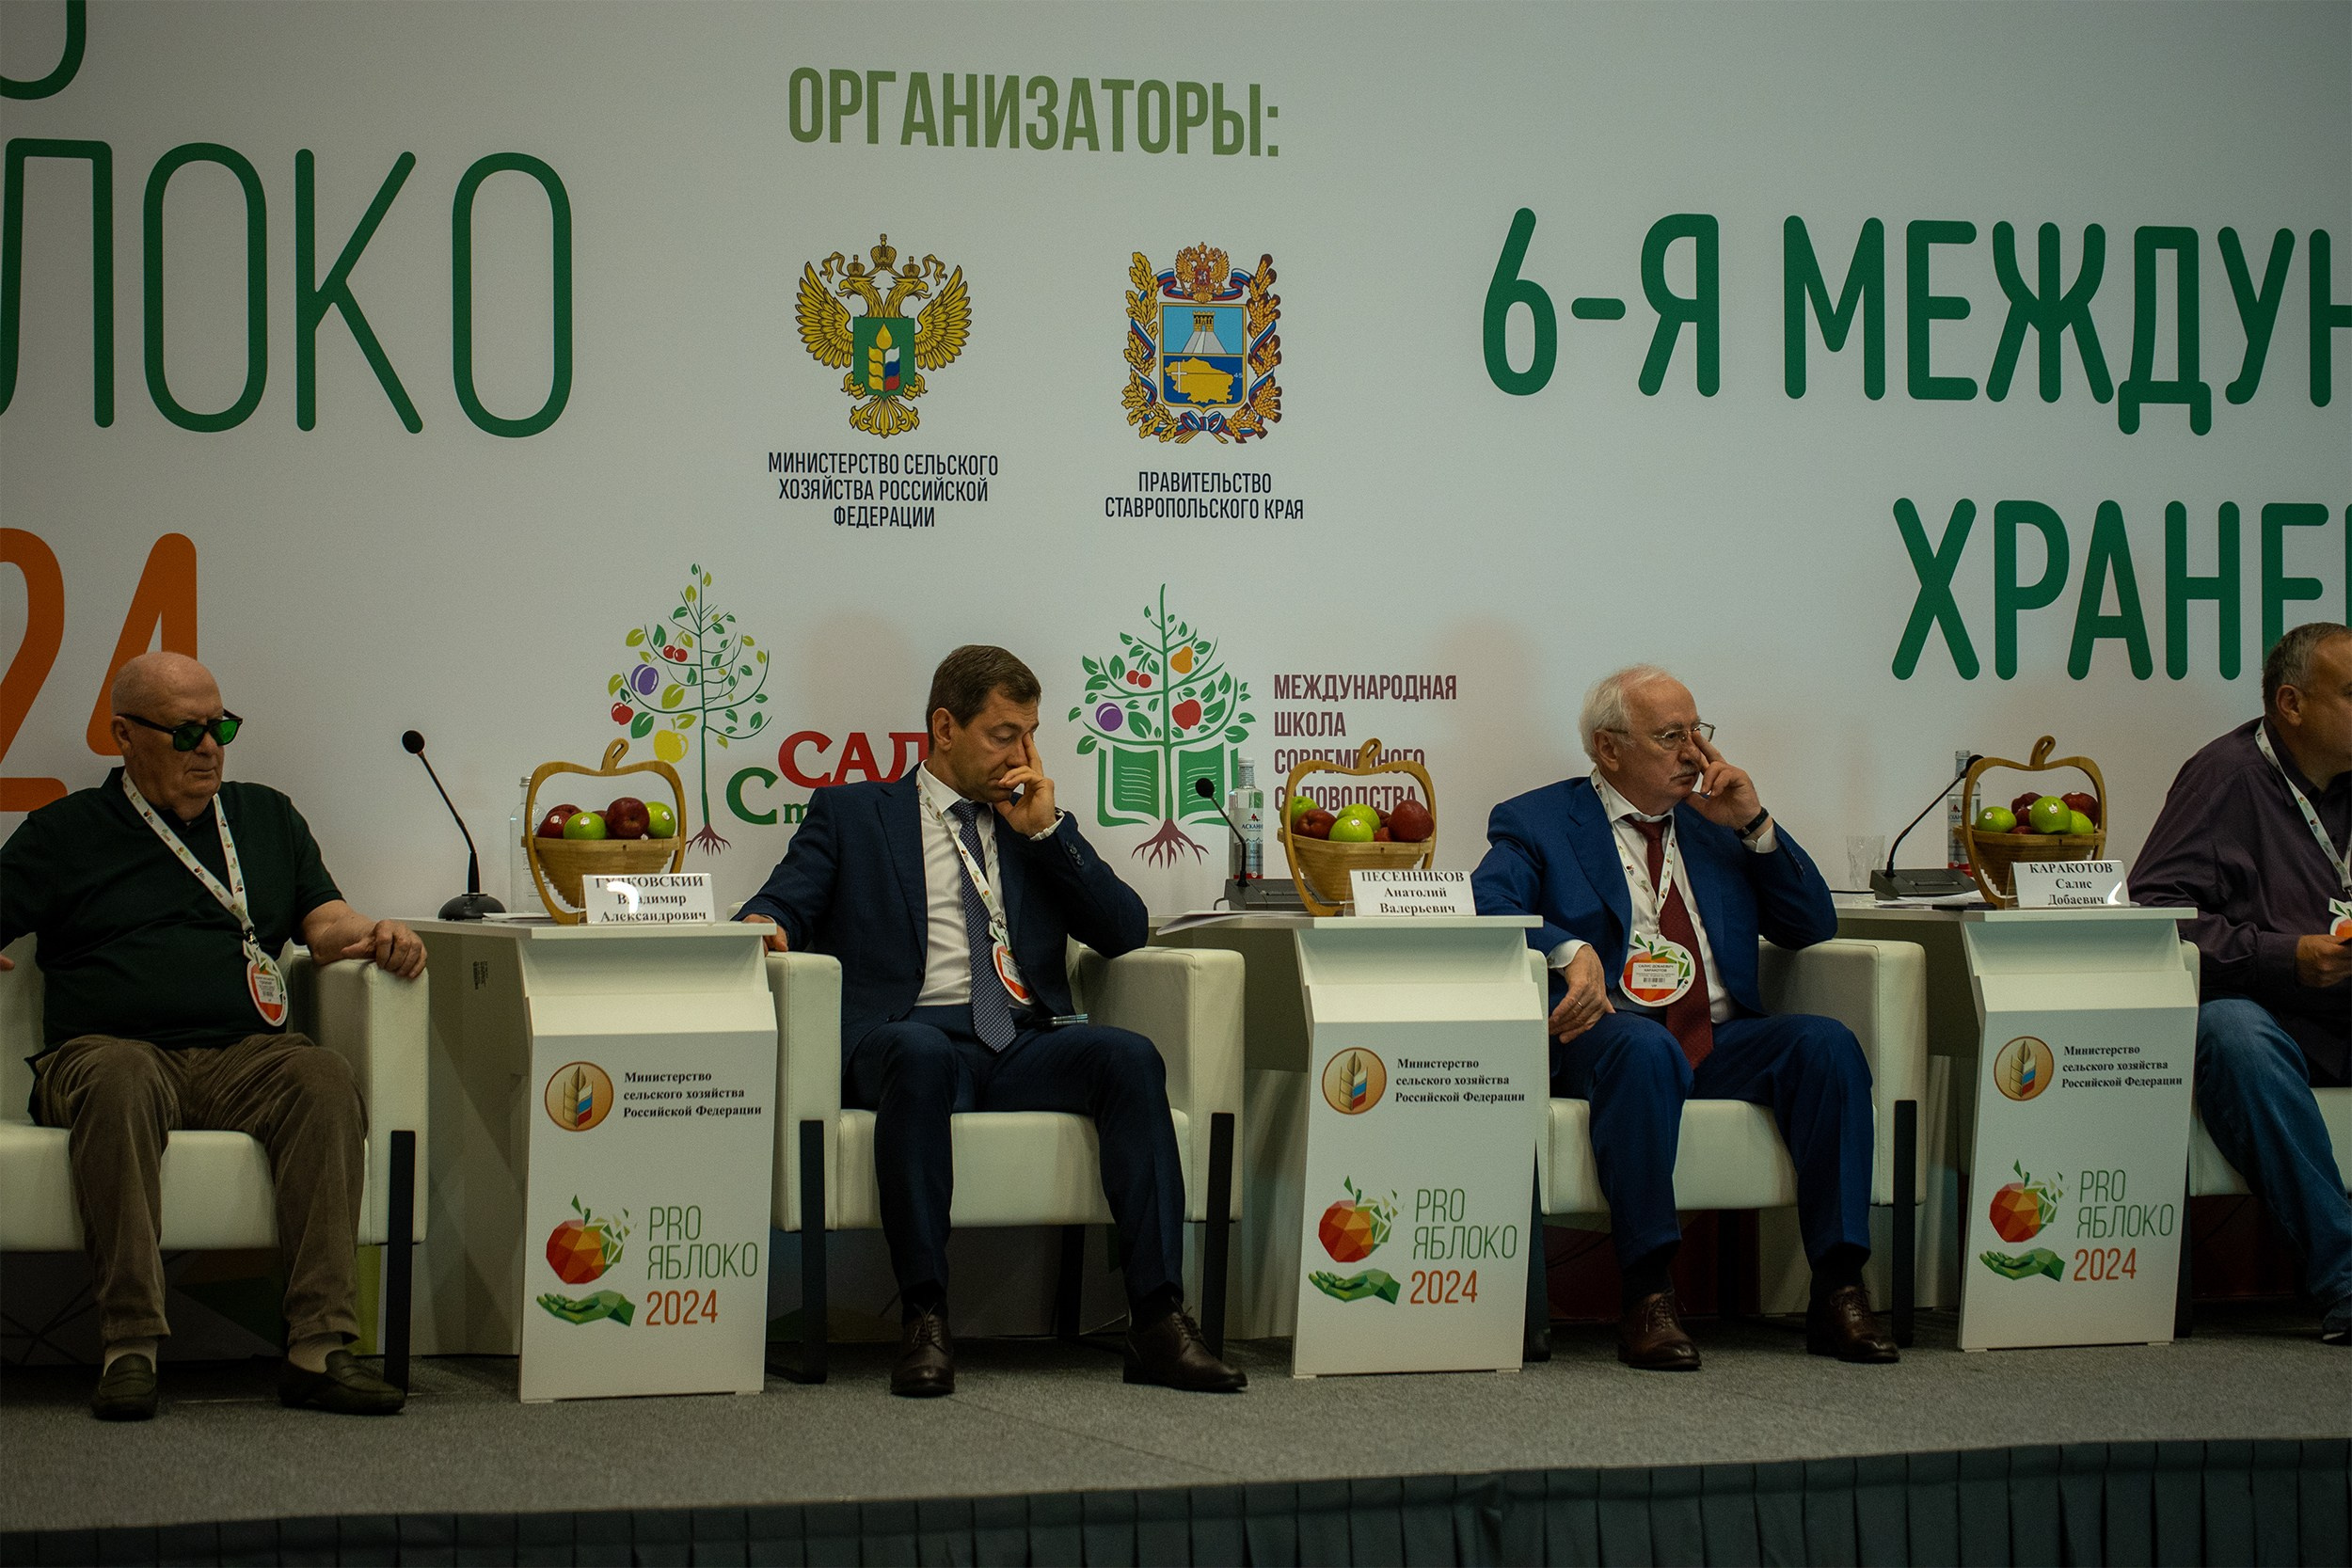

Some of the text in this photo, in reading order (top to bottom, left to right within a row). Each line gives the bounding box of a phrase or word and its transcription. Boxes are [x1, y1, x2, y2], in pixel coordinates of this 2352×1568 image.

[788, 67, 1279, 157] ОРГАНИЗАТОРЫ:
[1483, 208, 1720, 397] 6-Я
[769, 452, 999, 477] МИНИСТЕРСТВО СЕЛЬСКОГО
[779, 474, 989, 502] ХОЗЯЙСТВА РОССИЙСКОЙ
[1138, 471, 1272, 494] ПРАВИТЕЛЬСТВО
[834, 506, 935, 529] ФЕДЕРАЦИИ
[1104, 497, 1304, 520] СТАВРОПОЛЬСКОГО КРАЯ
[1892, 499, 2352, 681] ХРАНЕ
[1274, 674, 1457, 702] МЕЖДУНАРОДНАЯ
[1274, 711, 1346, 737] ШКОЛА
[1275, 749, 1425, 774] СОВРЕМЕНОГО
[1361, 871, 1465, 882] ПЕСЕННИКОВ
[2029, 863, 2113, 874] КАРАКОТОВ
[1384, 887, 1447, 897] Анатолий
[2056, 879, 2092, 889] Салис
[1379, 903, 1455, 915] Валерьевич
[2048, 895, 2105, 906] Добаевич
[601, 911, 707, 923] Александрович
[2064, 1046, 2140, 1055] Министерство
[1397, 1058, 1479, 1069] Министерство
[2063, 1060, 2168, 1072] сельского хозяйства
[624, 1071, 712, 1084] Министерство
[1396, 1074, 1509, 1086] сельского хозяйства
[2062, 1076, 2183, 1088] Российской Федерации
[624, 1087, 744, 1101] сельского хозяйства
[1395, 1091, 1525, 1104] Российской Федерации
[624, 1105, 762, 1117] Российской Федерации
[2079, 1169, 2126, 1202] PRO
[1416, 1189, 1465, 1223] PRO
[649, 1205, 701, 1242] PRO
[2077, 1204, 2174, 1239] ЯБЛОКО
[1413, 1225, 1518, 1259] ЯБЛОКО
[648, 1242, 758, 1280] ЯБЛОКО
[2074, 1247, 2137, 1281] 2024
[1410, 1270, 1478, 1305] 2024
[645, 1290, 718, 1326] 2024
